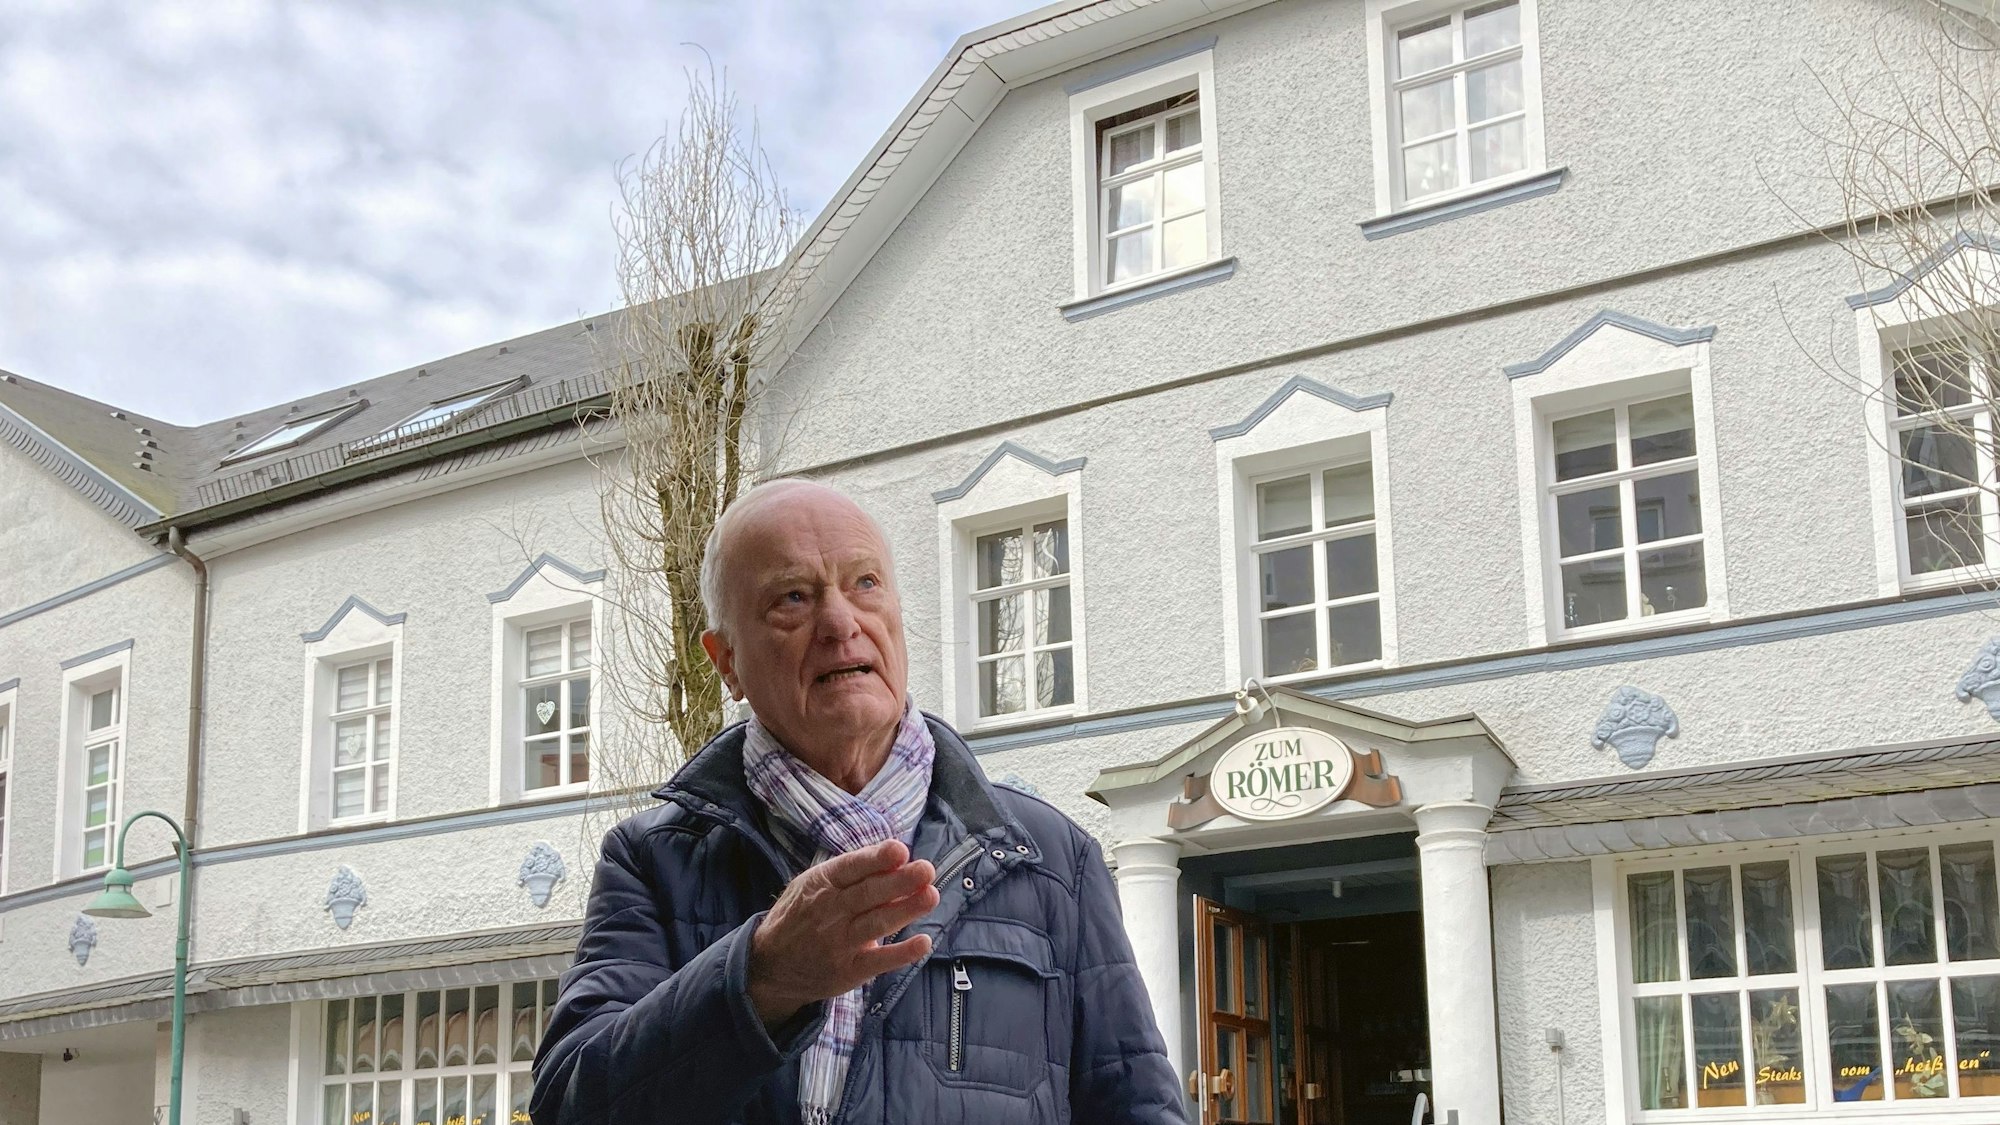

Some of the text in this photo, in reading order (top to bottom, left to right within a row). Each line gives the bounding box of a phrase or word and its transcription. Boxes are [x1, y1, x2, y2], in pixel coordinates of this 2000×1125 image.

[1254, 738, 1303, 761] ZUM
[1226, 759, 1337, 800] RÖMER
[1703, 1060, 1739, 1090] Neu
[1756, 1066, 1802, 1085] Steaks
[1840, 1065, 1871, 1077] vom
